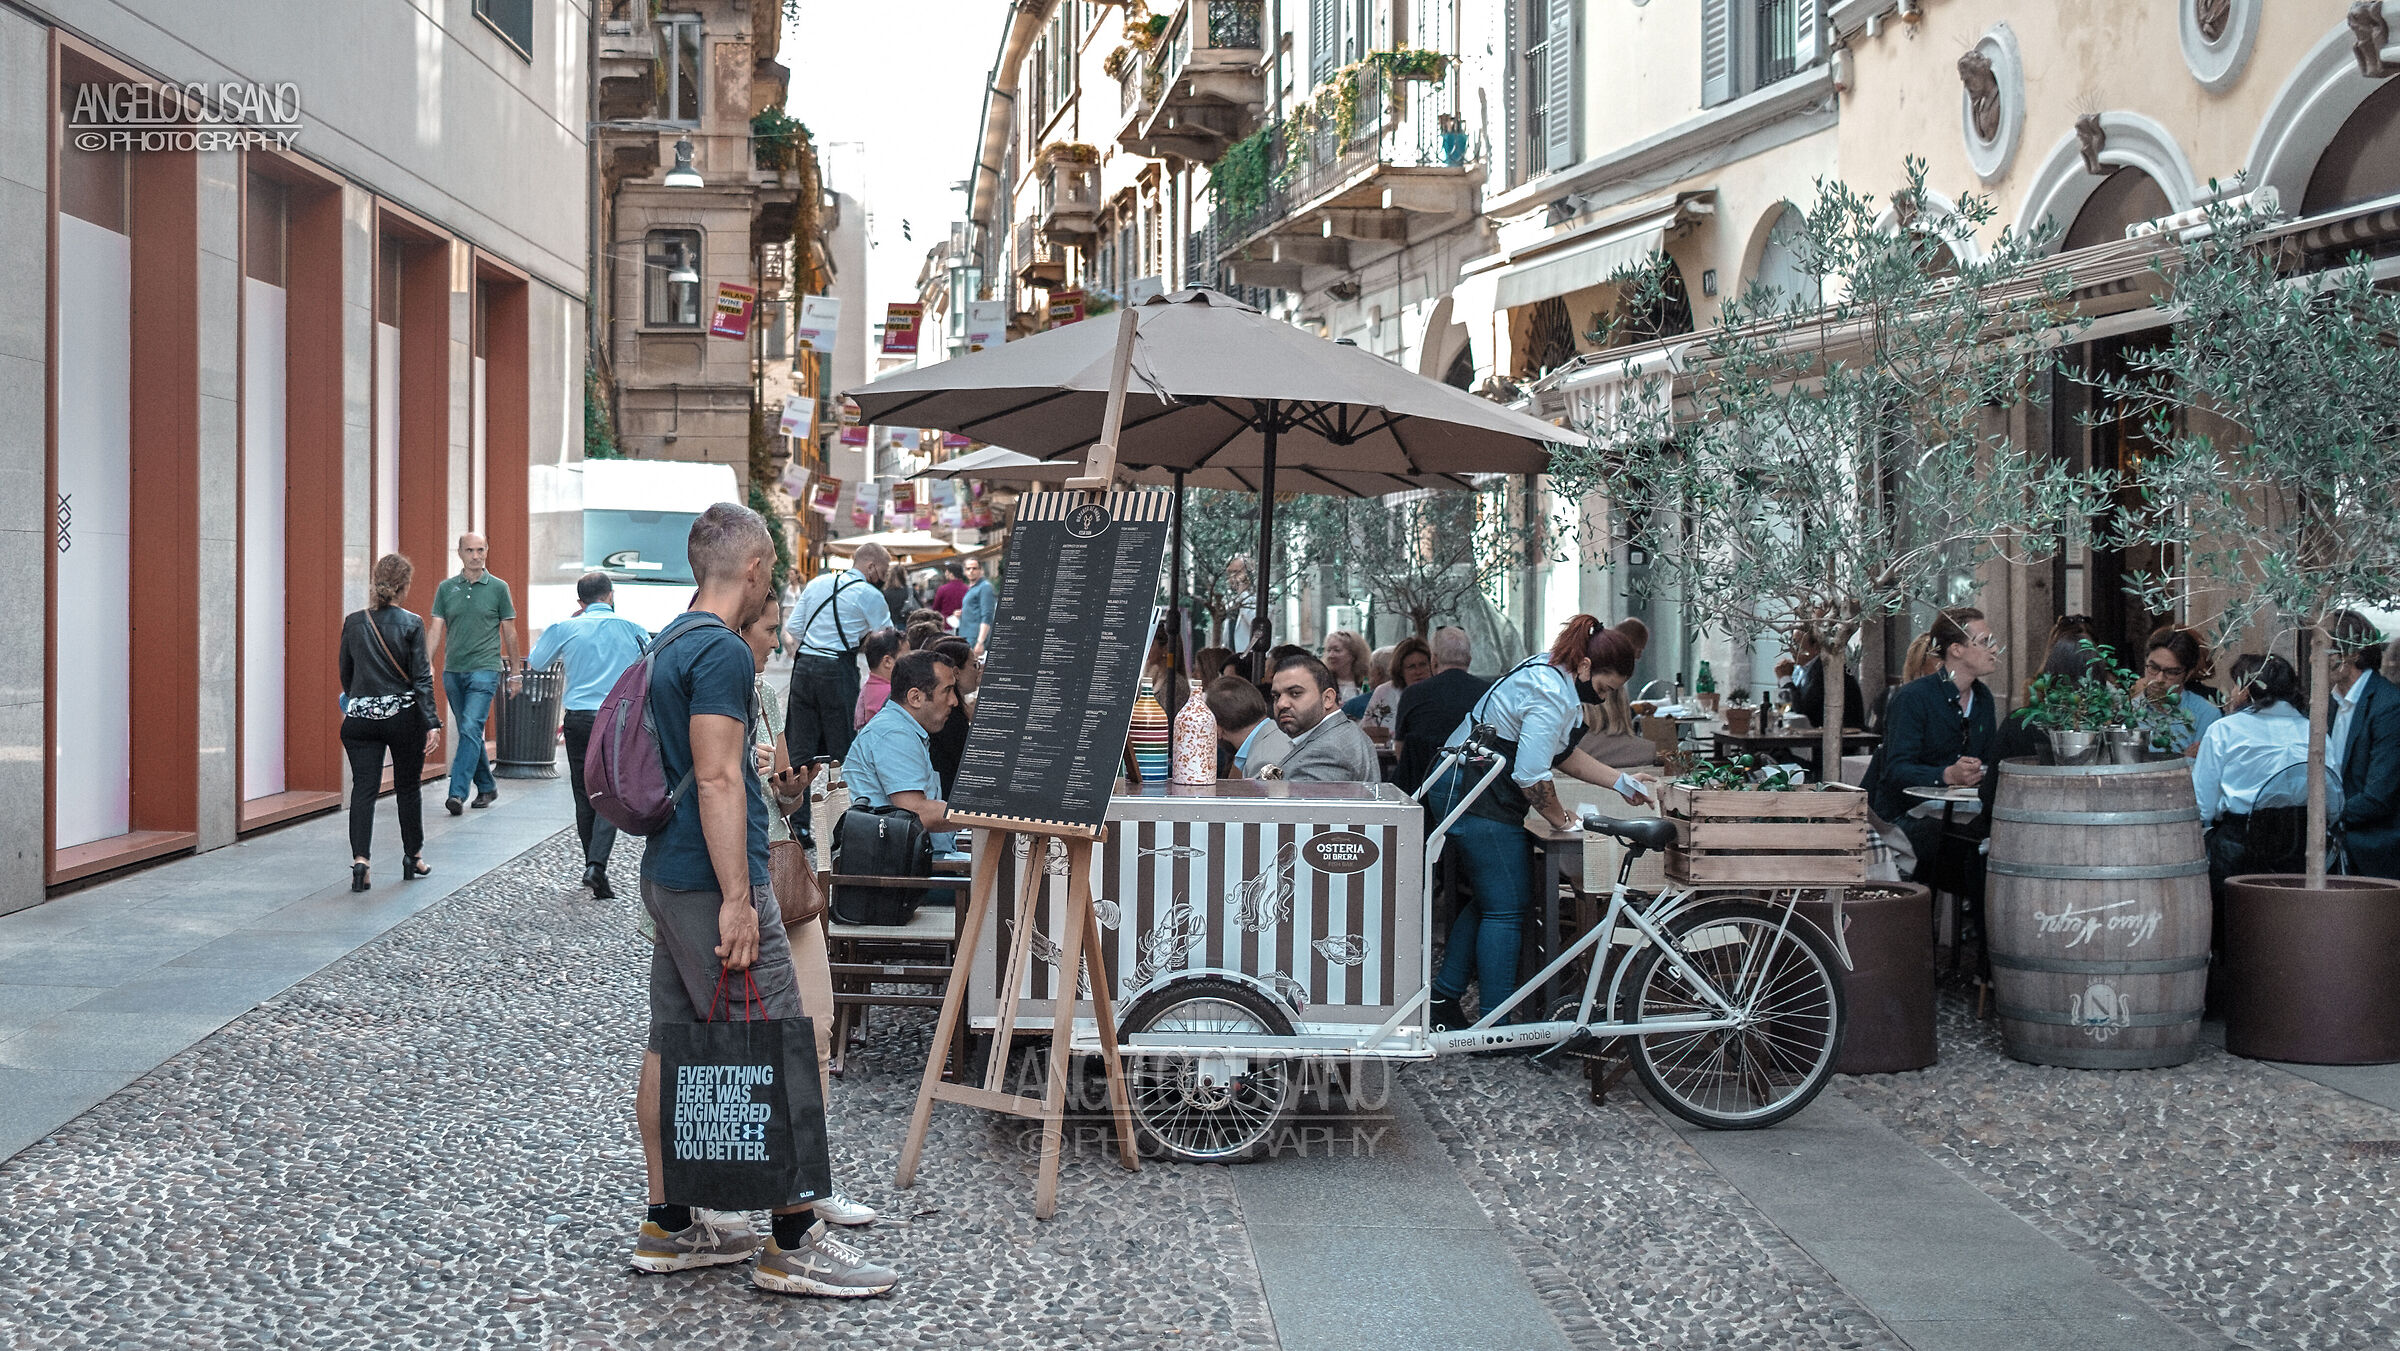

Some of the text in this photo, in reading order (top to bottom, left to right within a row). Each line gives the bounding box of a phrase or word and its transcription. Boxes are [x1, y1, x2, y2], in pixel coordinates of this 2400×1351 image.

[719, 298, 740, 306] WINE
[720, 290, 752, 301] MILANO
[717, 304, 743, 314] WEEK
[1316, 843, 1365, 854] OSTERIA
[1332, 853, 1358, 861] BRERA
[1448, 1036, 1476, 1048] street
[1519, 1029, 1551, 1041] mobile
[677, 1065, 774, 1085] EVERYTHING
[676, 1084, 751, 1103] HERE WAS
[674, 1103, 772, 1123] ENGINEERED
[674, 1122, 741, 1141] TO MAKE
[674, 1140, 770, 1161] YOU BETTER.
